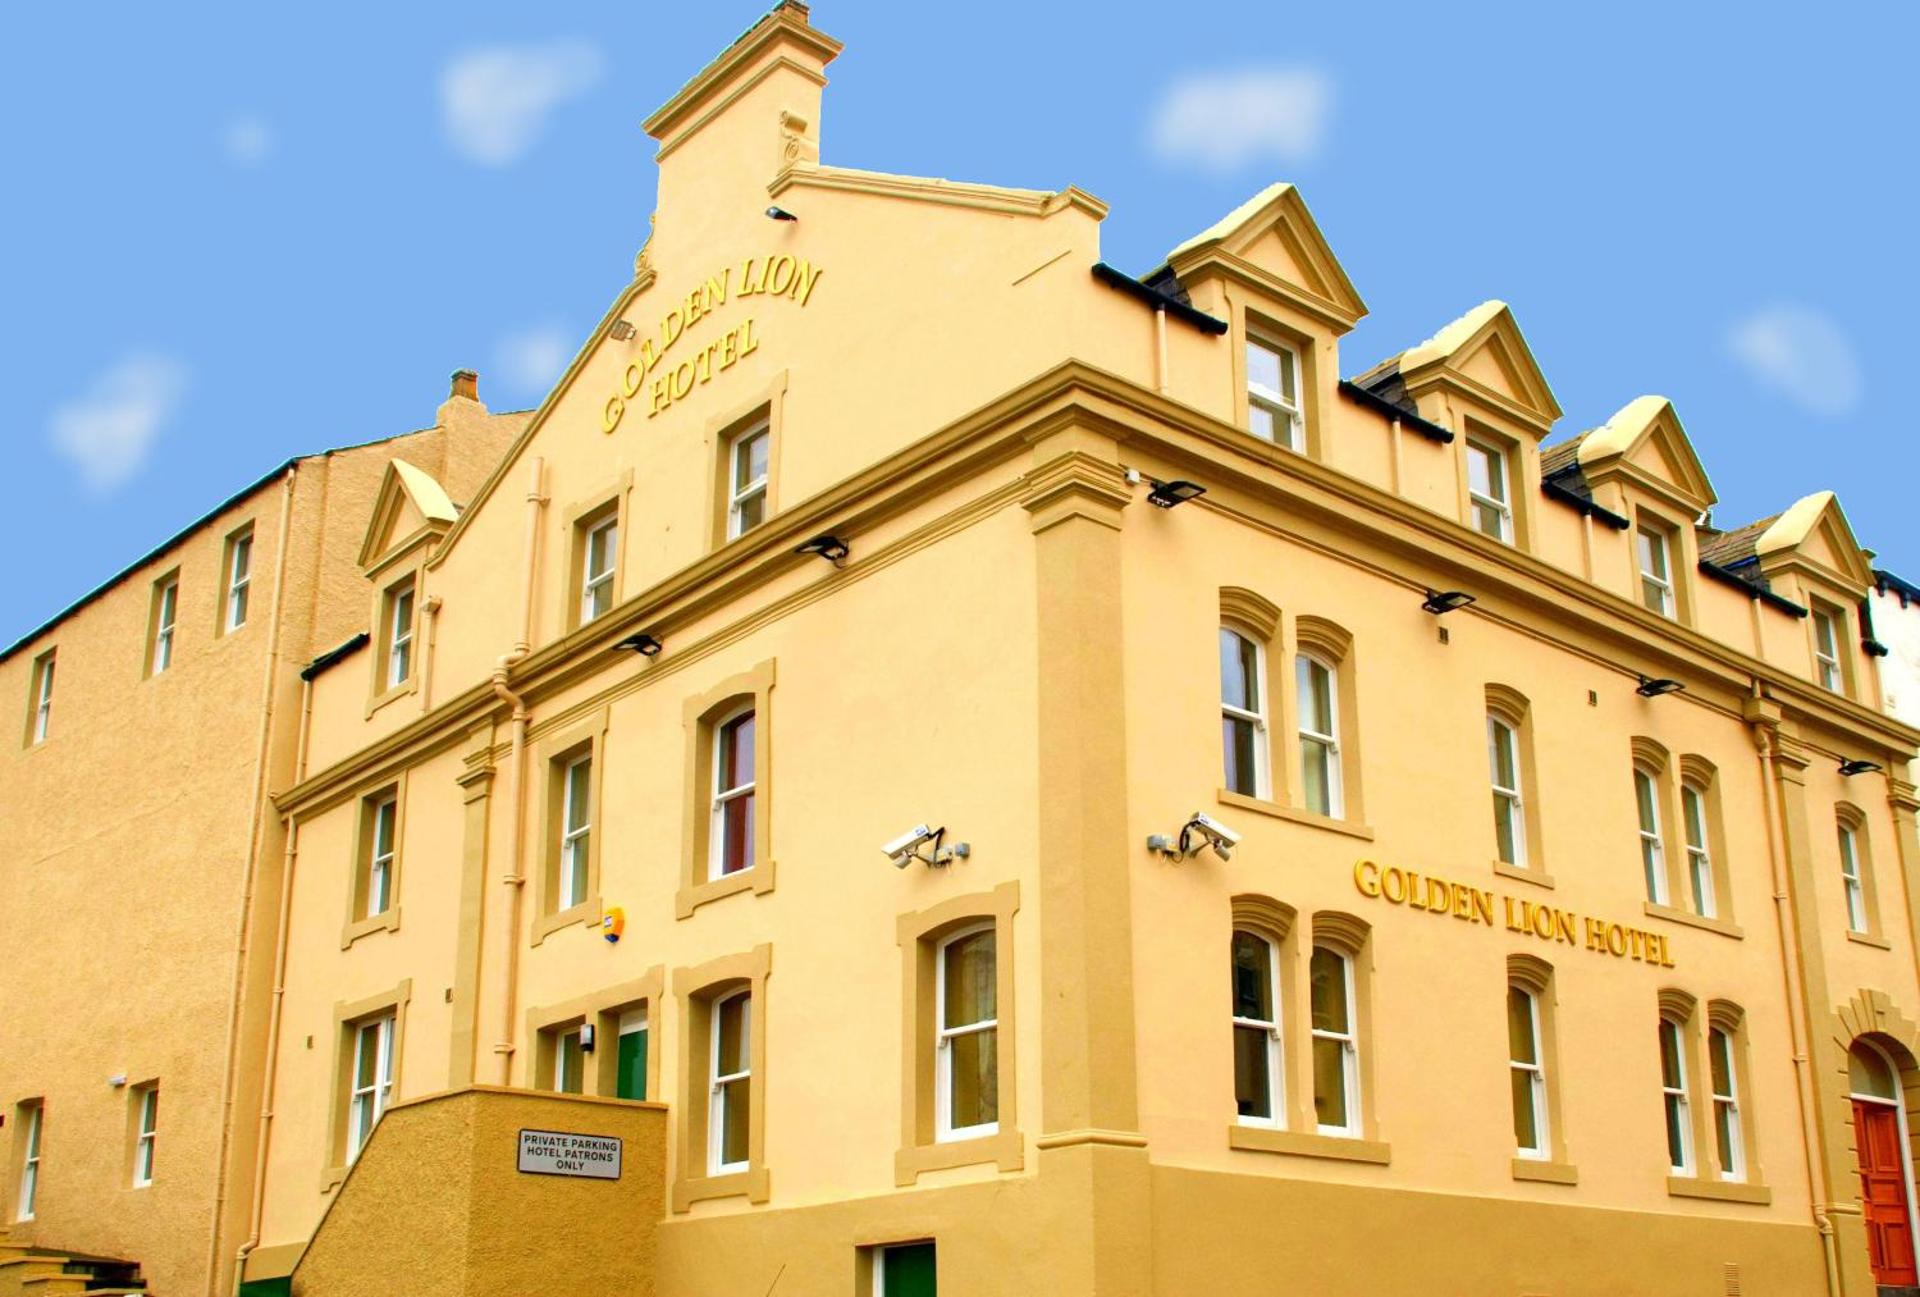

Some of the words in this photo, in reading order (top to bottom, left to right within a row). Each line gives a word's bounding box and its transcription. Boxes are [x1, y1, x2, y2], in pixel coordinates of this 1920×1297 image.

[602, 267, 730, 434] GOLDEN
[736, 253, 823, 307] LION
[648, 318, 759, 418] HOTEL
[1353, 858, 1494, 926] GOLDEN
[1503, 896, 1577, 946] LION
[1585, 916, 1676, 968] HOTEL
[524, 1134, 568, 1147] PRIVATE
[571, 1139, 617, 1152] PARKING
[527, 1146, 561, 1158] HOTEL
[565, 1149, 613, 1162] PATRONS
[556, 1159, 585, 1171] ONLY
